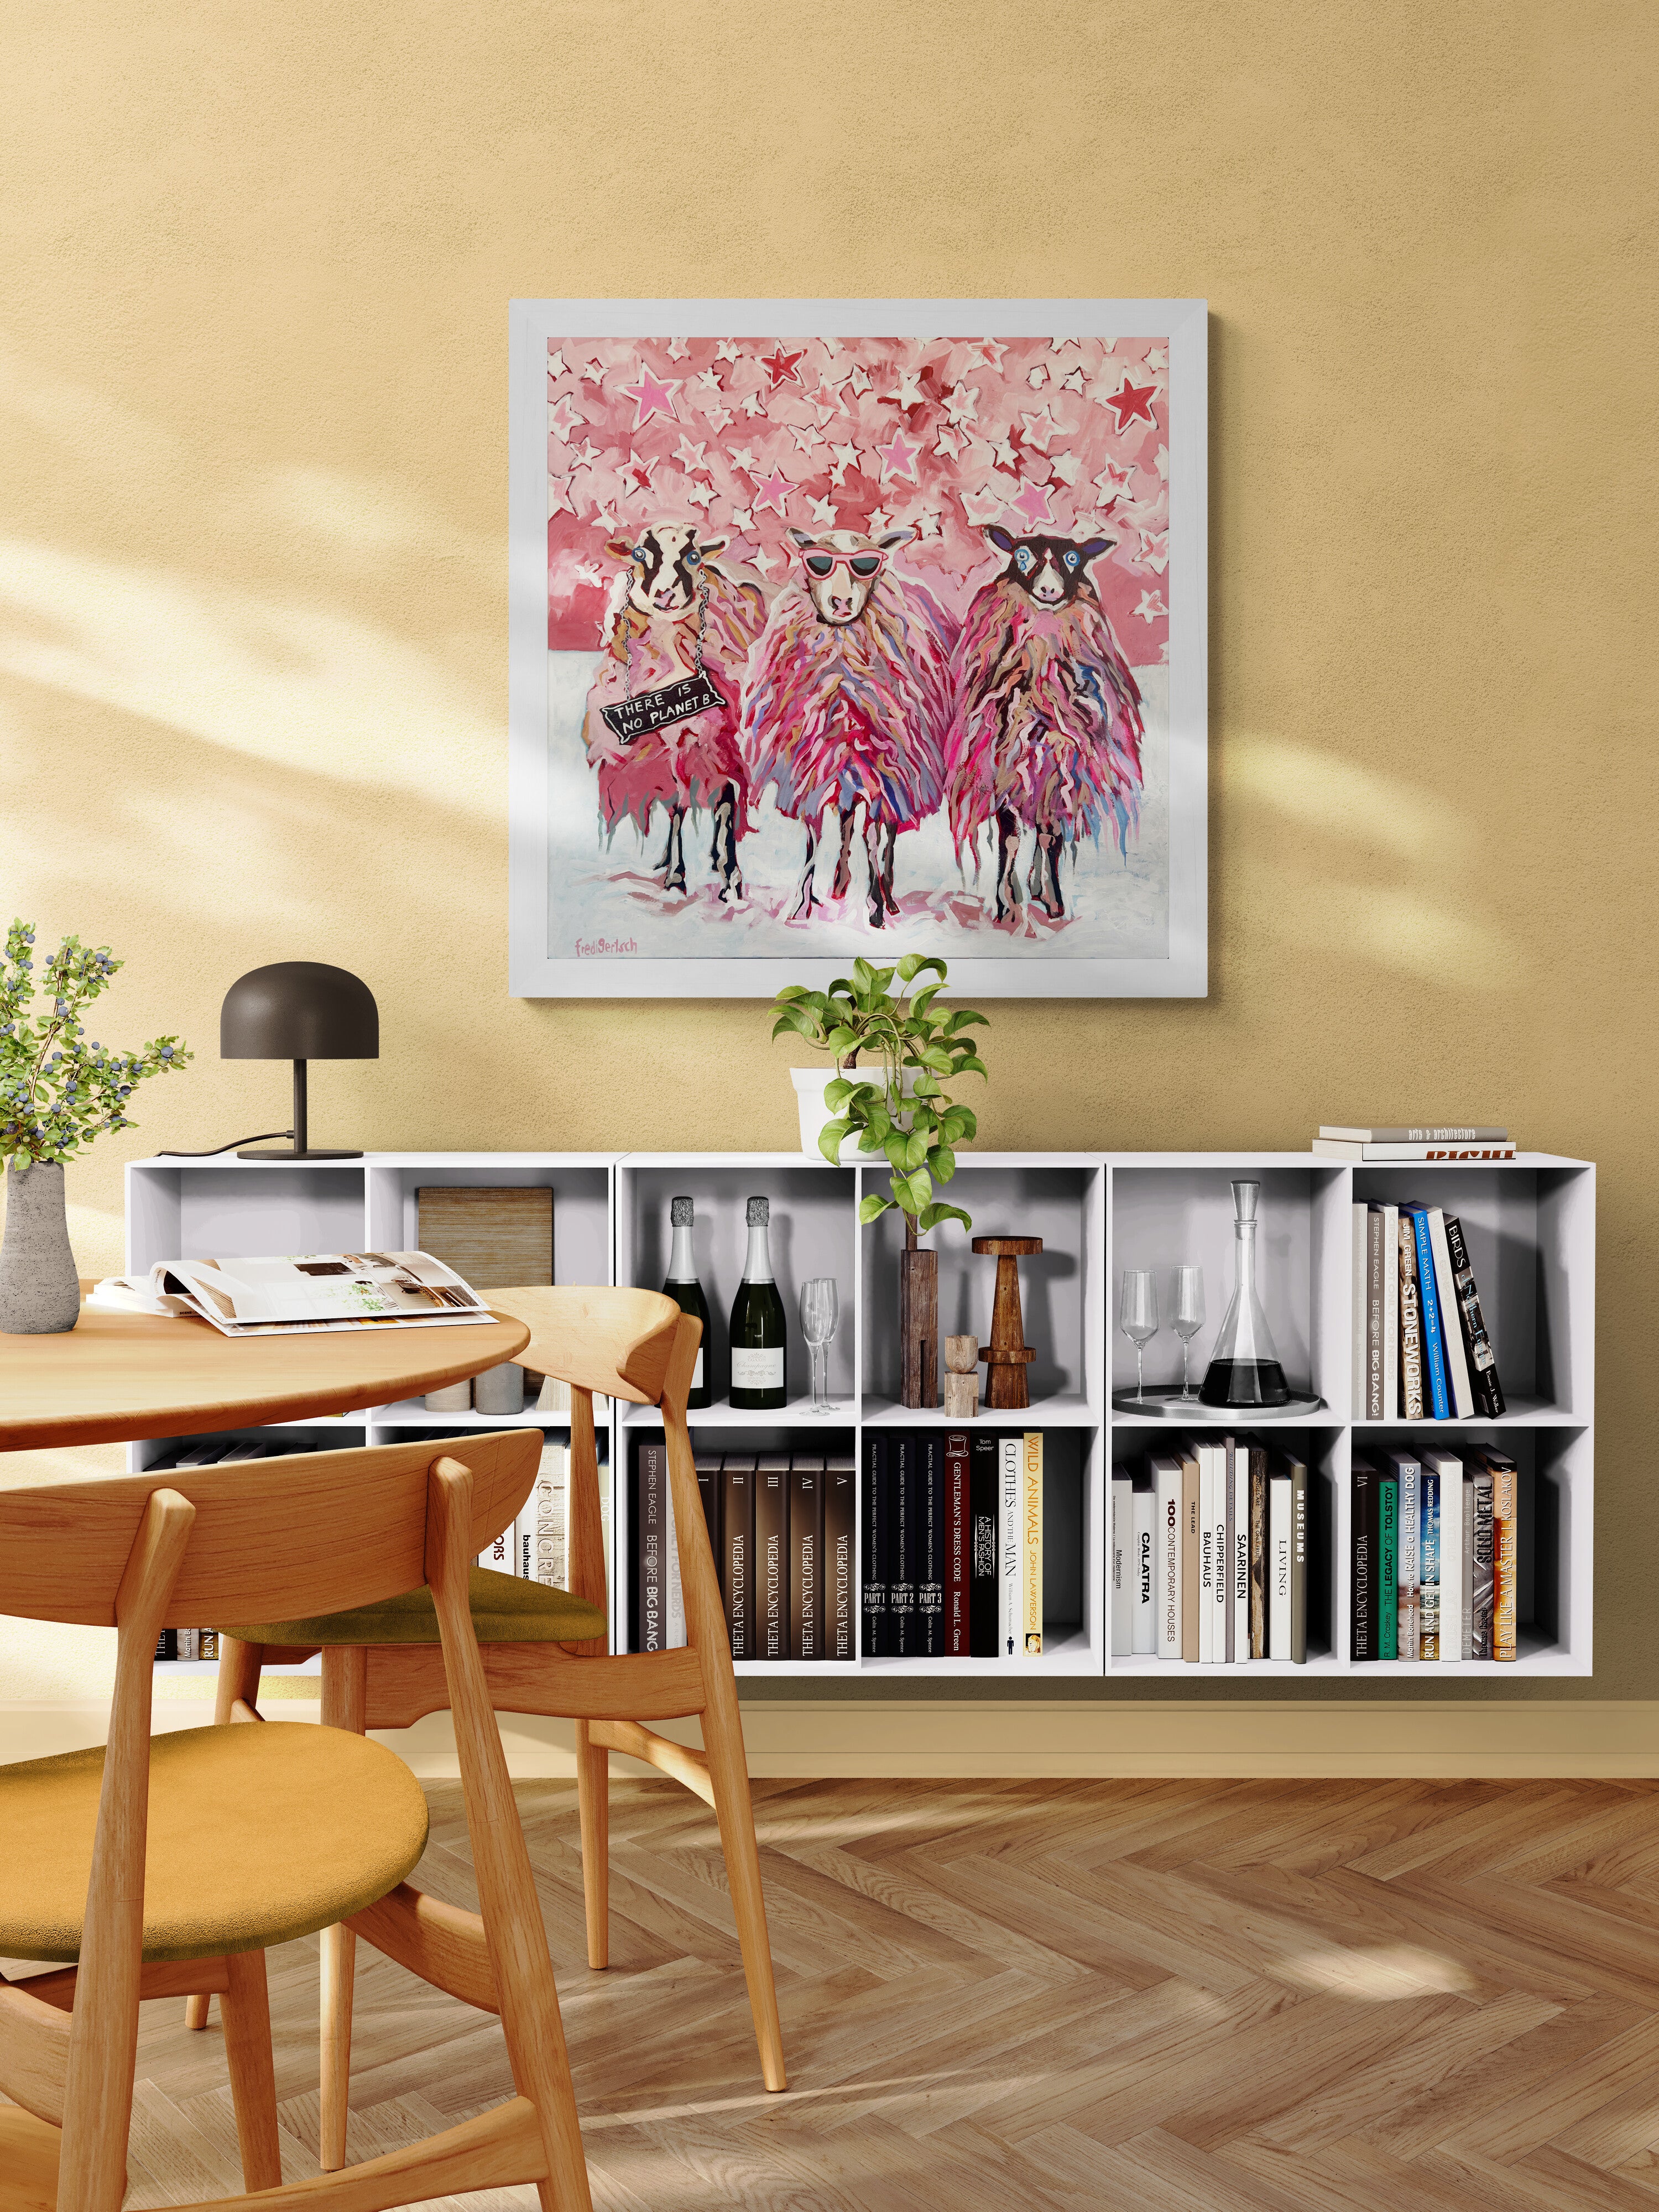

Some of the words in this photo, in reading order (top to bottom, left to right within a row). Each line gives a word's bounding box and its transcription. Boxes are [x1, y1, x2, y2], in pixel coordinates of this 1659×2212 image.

[614, 694, 665, 719] THERE
[678, 684, 691, 697] IS
[622, 718, 643, 734] NO
[650, 696, 700, 724] PLANET
[702, 693, 711, 705] B
[1408, 1129, 1423, 1140] arts
[1426, 1129, 1431, 1140] &
[1433, 1128, 1476, 1140] architecture
[1402, 1223, 1411, 1240] JIM
[1417, 1217, 1428, 1255] SIMPLE
[1404, 1244, 1412, 1276] GREEN
[1423, 1258, 1432, 1290] MATH
[1427, 1300, 1436, 1334] 2+2=4
[1448, 1225, 1465, 1267] BIRDS
[1464, 1284, 1478, 1328] Northern
[1473, 1329, 1486, 1364] Europe
[1485, 1370, 1494, 1387] Bessie
[1491, 1394, 1499, 1413] Walker
[1371, 1349, 1380, 1370] BIG
[1402, 1283, 1422, 1415] STONEWORKS
[1432, 1343, 1441, 1375] William
[1371, 1373, 1380, 1416] BANG!
[1436, 1378, 1445, 1413] Counter
[648, 1450, 656, 1491] STEPHEN
[1027, 1436, 1039, 1472] WILD
[768, 1477, 779, 1488] III
[803, 1477, 813, 1489] IV
[837, 1477, 848, 1485] V
[1005, 1443, 1016, 1507] CLOTHES
[1357, 1476, 1368, 1488] VI
[1405, 1467, 1415, 1490] DOG
[601, 1496, 611, 1521] DOG
[648, 1493, 656, 1524] EAGLE
[1027, 1476, 1039, 1545] ANIMALS
[1385, 1486, 1393, 1531] TOLSTOY
[1464, 1489, 1472, 1526] Boolienge
[1477, 1483, 1493, 1526] METAL
[1500, 1467, 1513, 1521] KOSLAKOV
[1405, 1491, 1415, 1533] HEALTHY
[1385, 1532, 1393, 1546] OF
[1425, 1540, 1435, 1572] SHAPE
[1477, 1530, 1493, 1564] SOLID
[647, 1535, 658, 1583] BEFORE
[985, 1563, 992, 1575] OF
[1005, 1542, 1016, 1576] MAN
[1142, 1532, 1150, 1604] CALATRA
[1203, 1532, 1211, 1588] BAUHAUS
[1237, 1534, 1246, 1599] SAARINEN
[1385, 1547, 1393, 1587] LEGACY
[1405, 1545, 1415, 1572] RAISE
[1500, 1537, 1513, 1586] MASTER
[733, 1535, 744, 1618] ENCYCLOPEDIA
[768, 1535, 779, 1618] ENCYCLOPEDIA
[803, 1535, 813, 1618] ENCYCLOPEDIA
[837, 1535, 848, 1618] ENCYCLOPEDIA
[1356, 1535, 1368, 1618] ENCYCLOPEDIA
[1406, 1582, 1415, 1597] How
[1425, 1574, 1435, 1586] IN
[1500, 1587, 1513, 1599] A
[646, 1587, 659, 1609] BIG
[864, 1593, 880, 1604] PART
[881, 1593, 885, 1604] 1
[891, 1593, 907, 1604] PART
[910, 1593, 914, 1604] 2
[919, 1593, 936, 1604] PART
[937, 1593, 941, 1604] 3
[1425, 1588, 1435, 1608] GET
[1500, 1602, 1513, 1626] LIKE
[1167, 1604, 1176, 1642] HOUSES
[1406, 1604, 1415, 1636] Bonehead
[1425, 1612, 1435, 1634] AND
[1462, 1608, 1471, 1654] DEMETER
[204, 1635, 214, 1658] RUN
[733, 1621, 744, 1656] THETA
[768, 1621, 779, 1656] THETA
[803, 1621, 813, 1656] THETA
[837, 1621, 848, 1656] THETA
[1356, 1622, 1368, 1657] THETA
[1384, 1640, 1390, 1649] M.
[1406, 1637, 1415, 1658] Martin
[1425, 1635, 1435, 1658] RUN
[1500, 1630, 1513, 1658] PLAY
